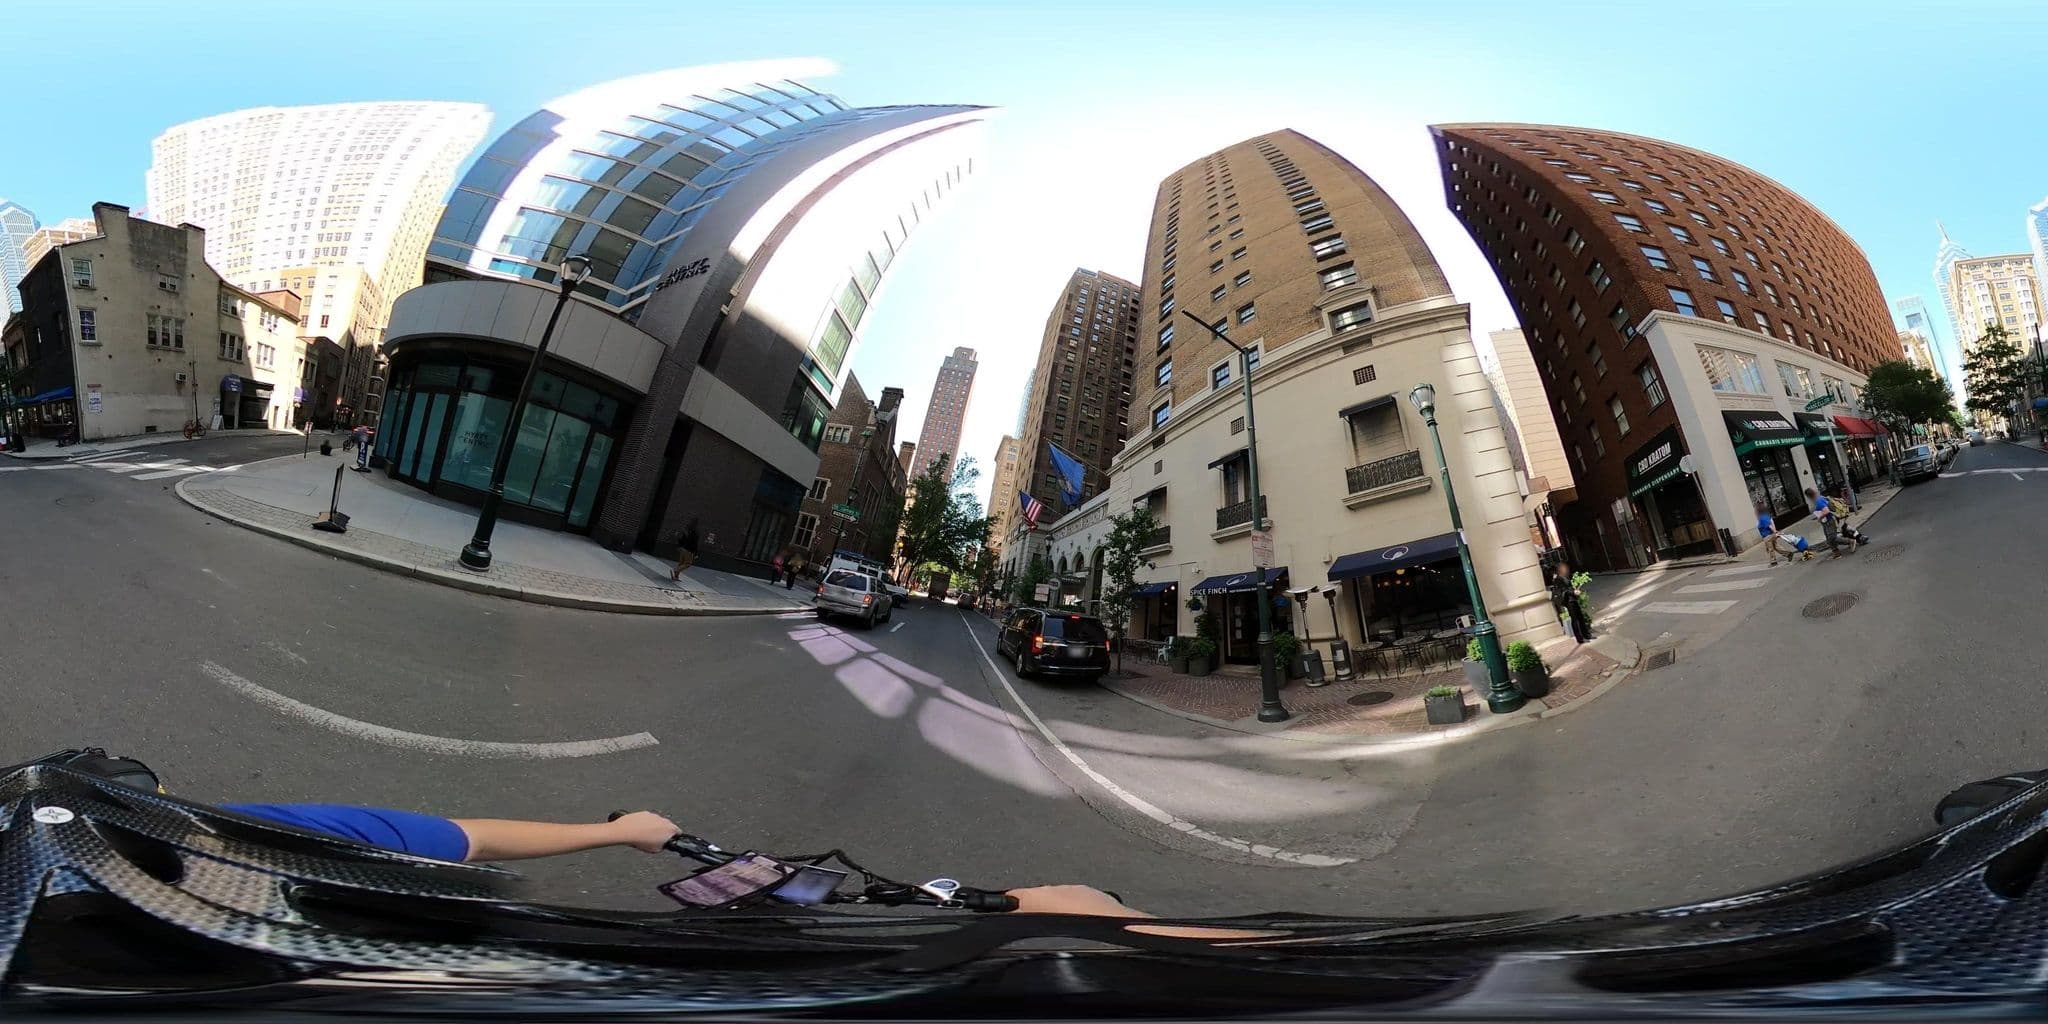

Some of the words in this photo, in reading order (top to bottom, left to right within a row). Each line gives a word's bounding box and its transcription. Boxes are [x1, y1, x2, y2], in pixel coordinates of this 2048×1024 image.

[656, 265, 710, 291] CENTRIC
[1638, 457, 1648, 472] CBD
[1648, 441, 1671, 465] KRATOM
[1632, 483, 1651, 496] CANNABIS
[1651, 467, 1679, 486] DISPENSARY
[1190, 589, 1206, 597] SPICE
[1207, 587, 1227, 595] FINCH
